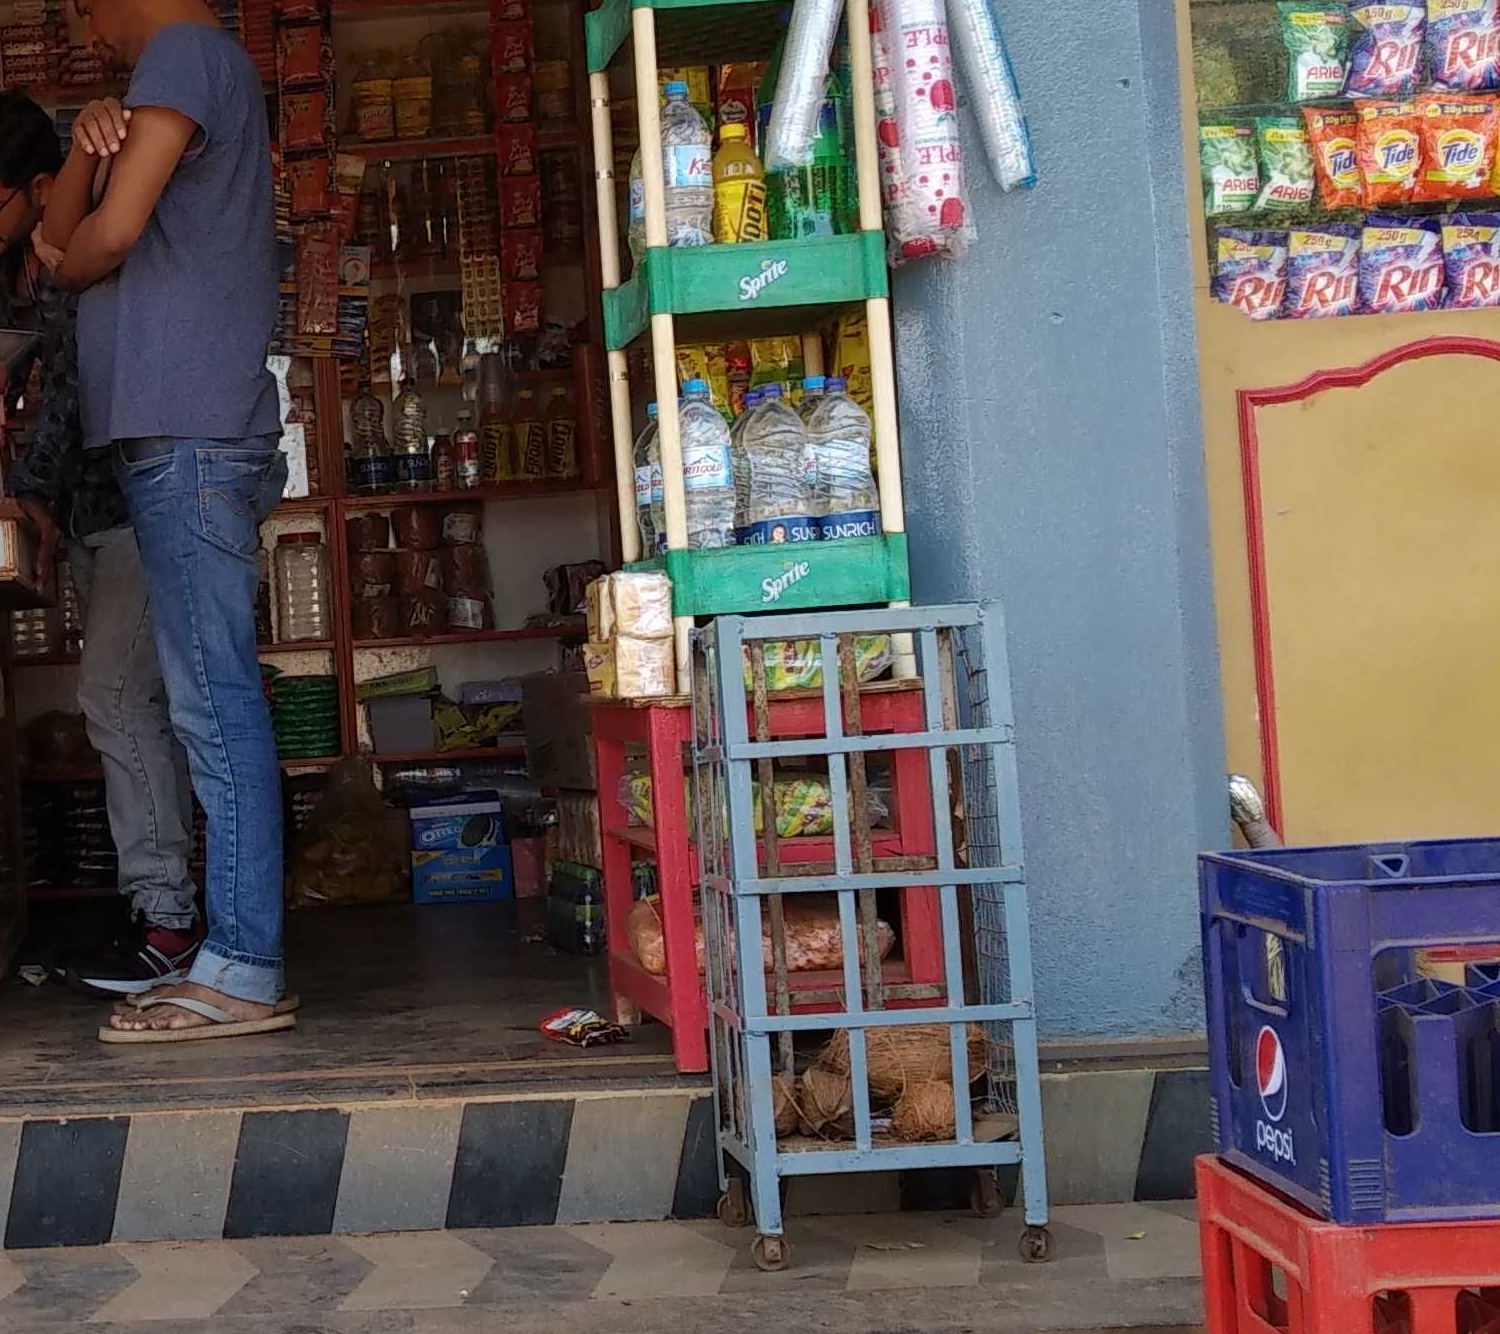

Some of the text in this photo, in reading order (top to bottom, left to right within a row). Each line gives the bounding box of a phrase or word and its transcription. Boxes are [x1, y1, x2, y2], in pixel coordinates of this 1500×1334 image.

[1382, 145, 1414, 168] Tide
[1442, 141, 1478, 165] Tide
[739, 258, 789, 303] Sprite
[1376, 264, 1442, 303] RIN
[821, 520, 876, 540] SUNRICH
[760, 561, 811, 604] Sprite
[1256, 1118, 1294, 1162] pepsi
